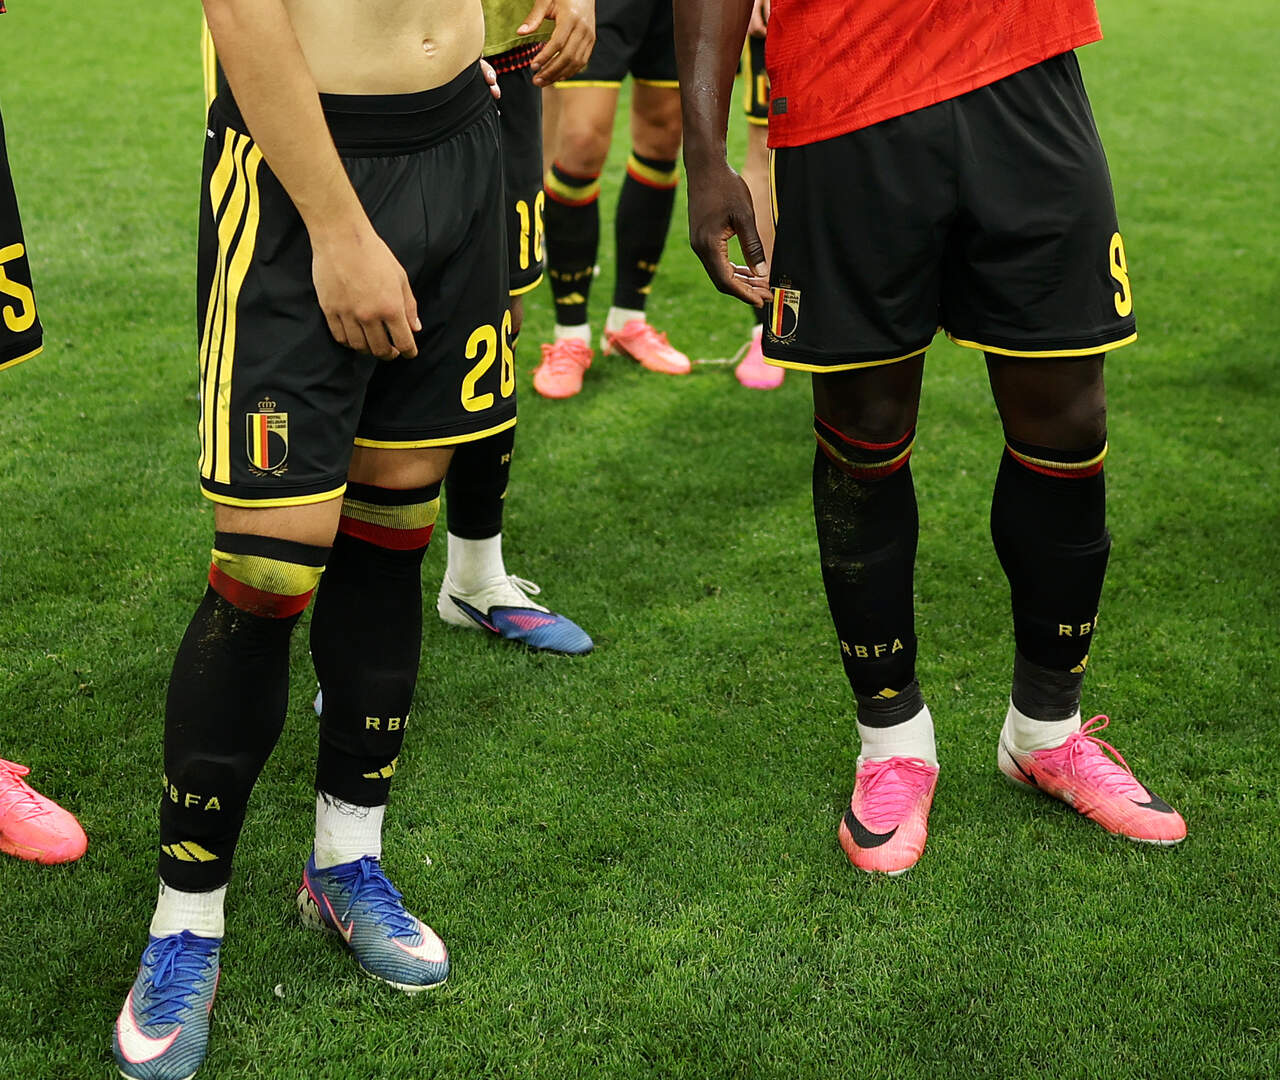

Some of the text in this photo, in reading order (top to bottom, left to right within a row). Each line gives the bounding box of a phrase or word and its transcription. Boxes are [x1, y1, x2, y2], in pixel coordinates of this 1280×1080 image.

[1108, 231, 1133, 318] 9
[460, 308, 516, 413] 26
[840, 638, 905, 658] RBFA
[365, 713, 411, 734] RB
